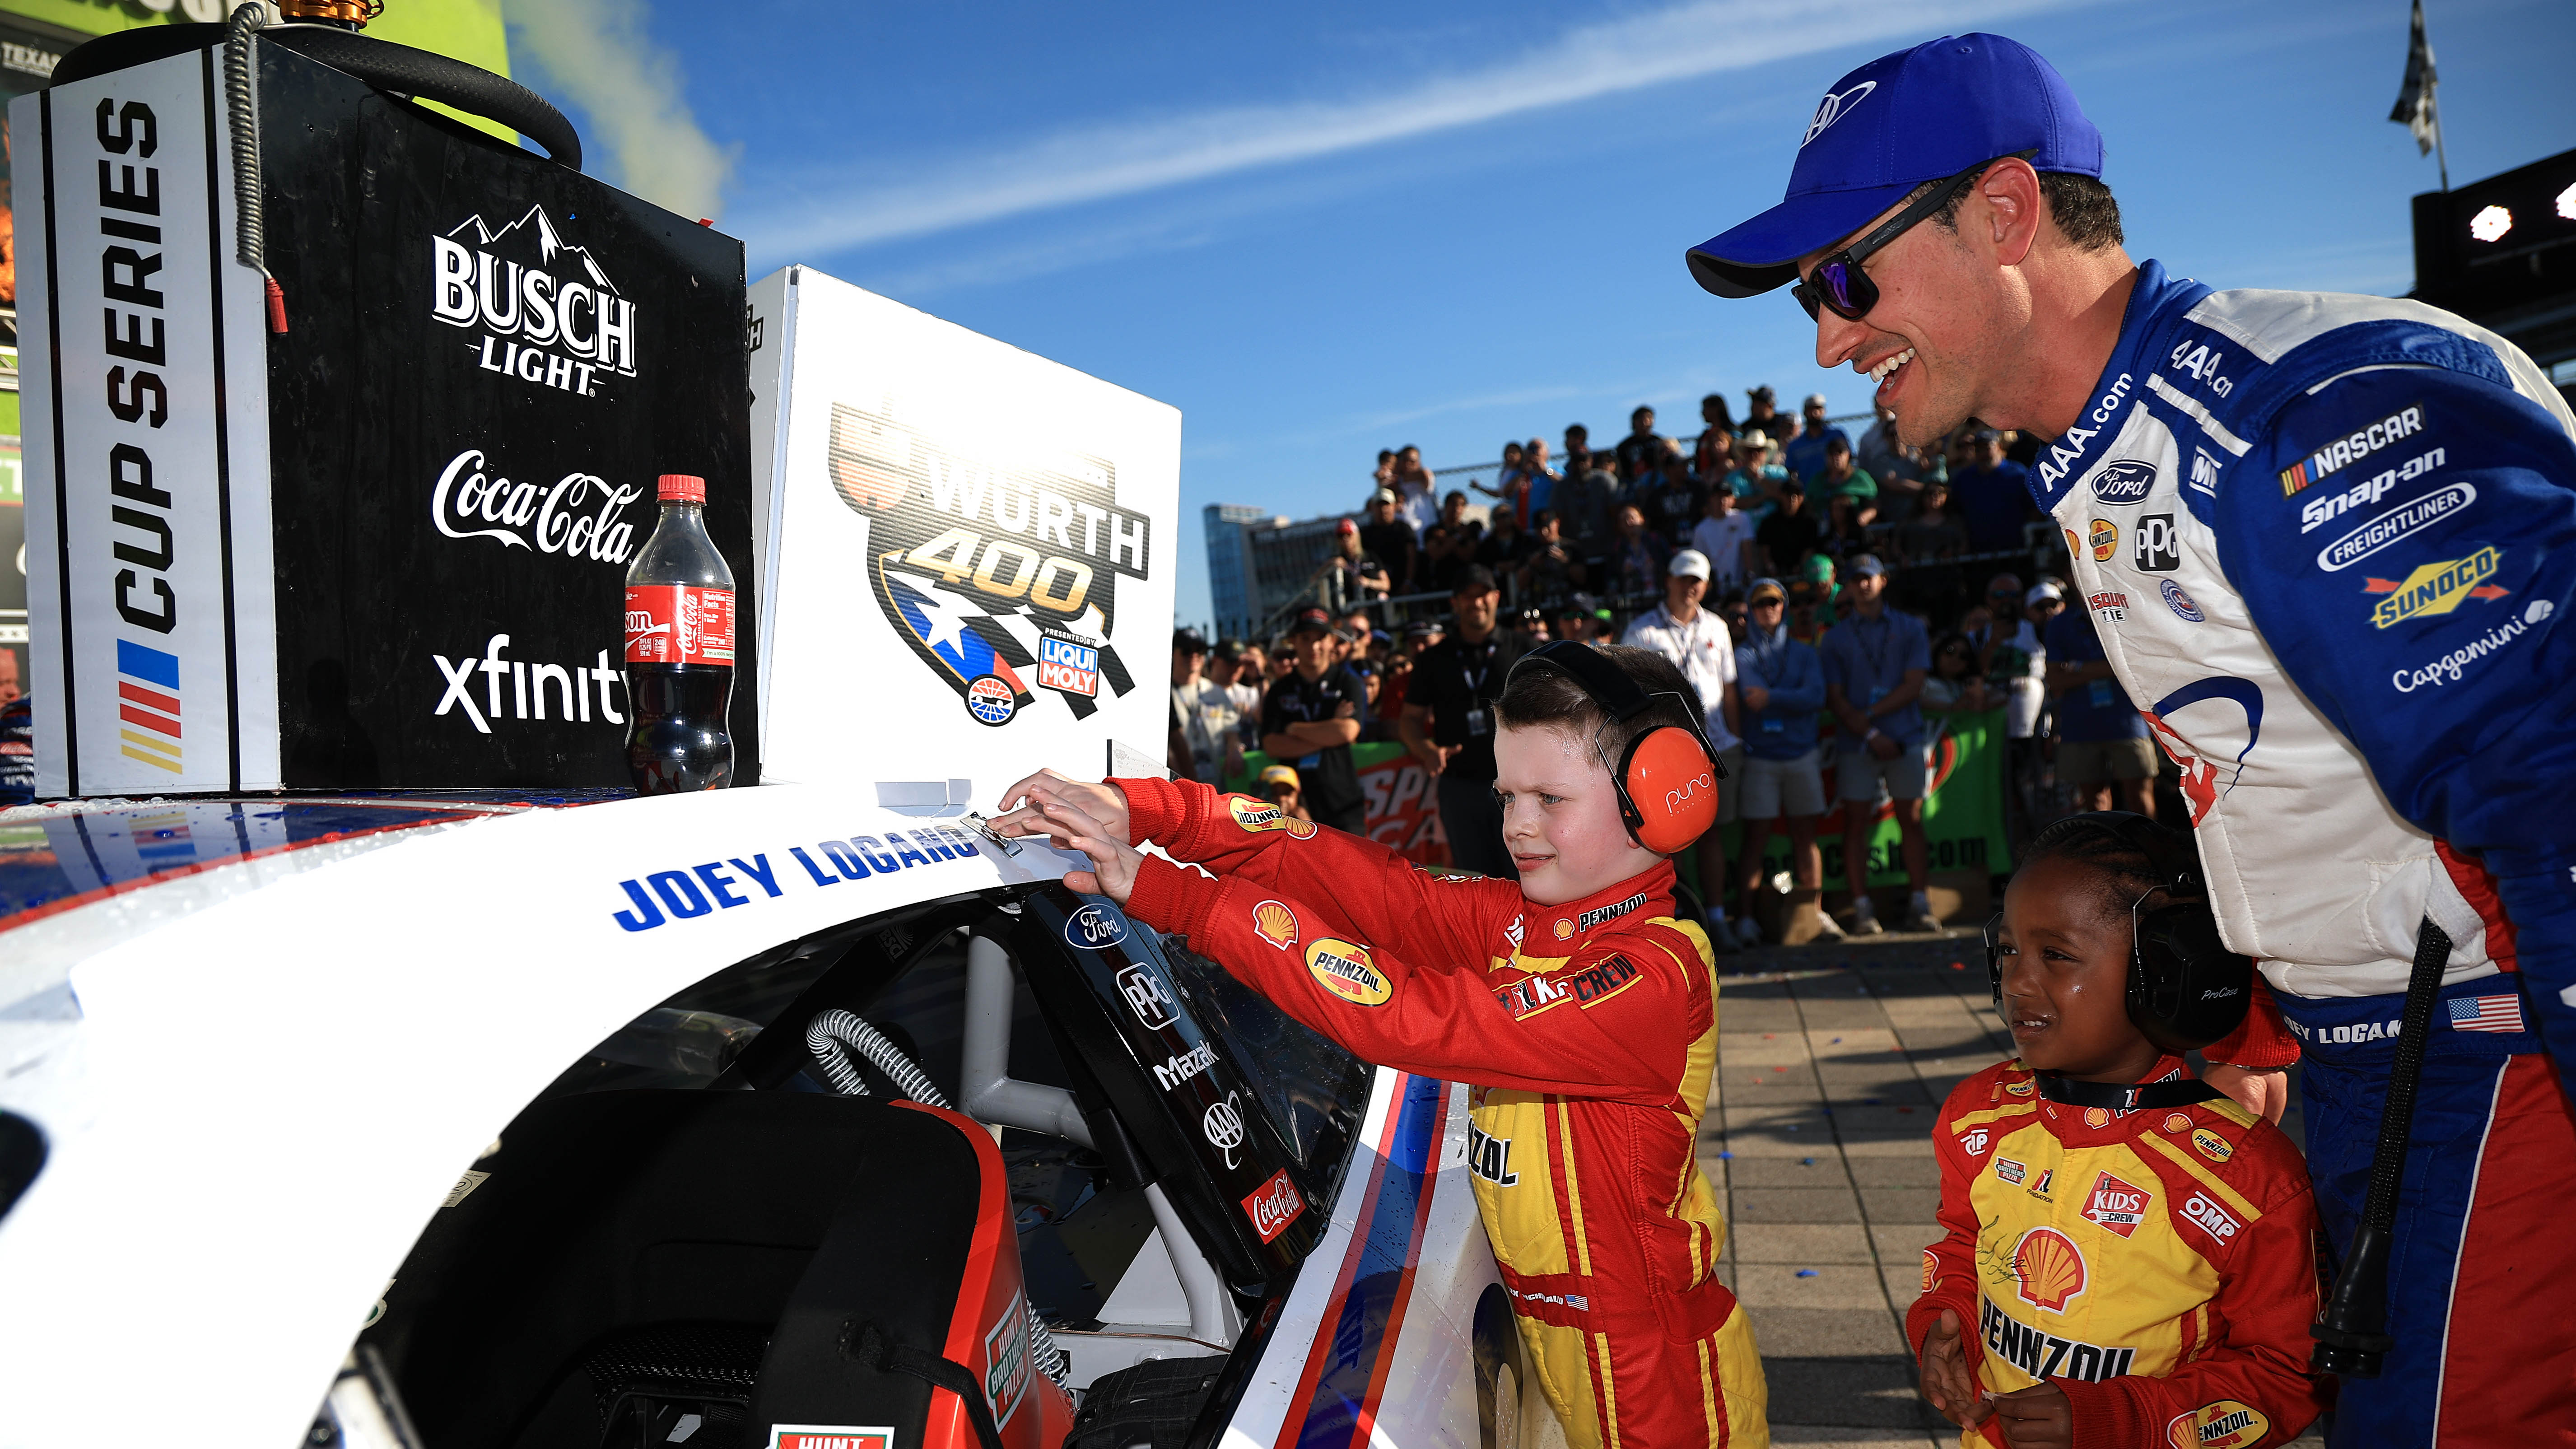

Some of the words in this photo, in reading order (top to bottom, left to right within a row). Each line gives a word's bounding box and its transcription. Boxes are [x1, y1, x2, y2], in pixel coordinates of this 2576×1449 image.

[96, 97, 168, 429] SERIES
[431, 235, 637, 377] BUSCH
[480, 335, 596, 396] LIGHT
[2038, 372, 2133, 492] AAA.com
[2314, 407, 2422, 478] NASCAR
[2101, 468, 2148, 497] Ford
[2301, 447, 2446, 533] Snap-on
[433, 450, 643, 564] Coca-Cola
[2334, 491, 2460, 563] FREIGHTLINER
[110, 442, 176, 634] CUP
[2135, 519, 2178, 567] PPG
[905, 527, 1093, 612] 400
[2379, 552, 2494, 626] SUNOCO
[704, 592, 726, 601] Nutrition
[1044, 640, 1095, 671] LIQUI
[1045, 627, 1085, 643] PRESENTED
[1086, 638, 1095, 646] BY
[2393, 615, 2528, 692] Capgemini
[433, 634, 629, 733] xfinit
[1042, 663, 1095, 692] MOLY
[1236, 809, 1282, 824] ENNZOIL
[612, 854, 783, 932] JOEY
[789, 825, 980, 887] LOGANO
[1080, 909, 1121, 942] Ford
[1125, 973, 1172, 1019] PPG
[1314, 951, 1381, 994] PENNZOIL
[1573, 955, 1637, 1002] CREW
[2201, 987, 2238, 1000] ProCase
[2283, 1015, 2310, 1040] OEY
[2319, 1020, 2402, 1044] LOGAN
[1152, 1039, 1220, 1091] Mazak
[1204, 1103, 1243, 1148] AAA
[2194, 1134, 2230, 1158] PENNZOIL
[1998, 1165, 2024, 1178] BROTHERS
[2002, 1171, 2018, 1181] PIZZA
[2003, 1160, 2019, 1170] HUNT
[1253, 1174, 1298, 1236] Coca-Cola
[2093, 1191, 2141, 1211] KIDS
[2108, 1212, 2134, 1223] CREW
[2185, 1197, 2235, 1237] OMP
[998, 1312, 1018, 1360] HUNT
[991, 1325, 1026, 1396] BROTHERS
[1003, 1356, 1025, 1406] PIZZA
[2198, 1410, 2254, 1441] ENNZOIL
